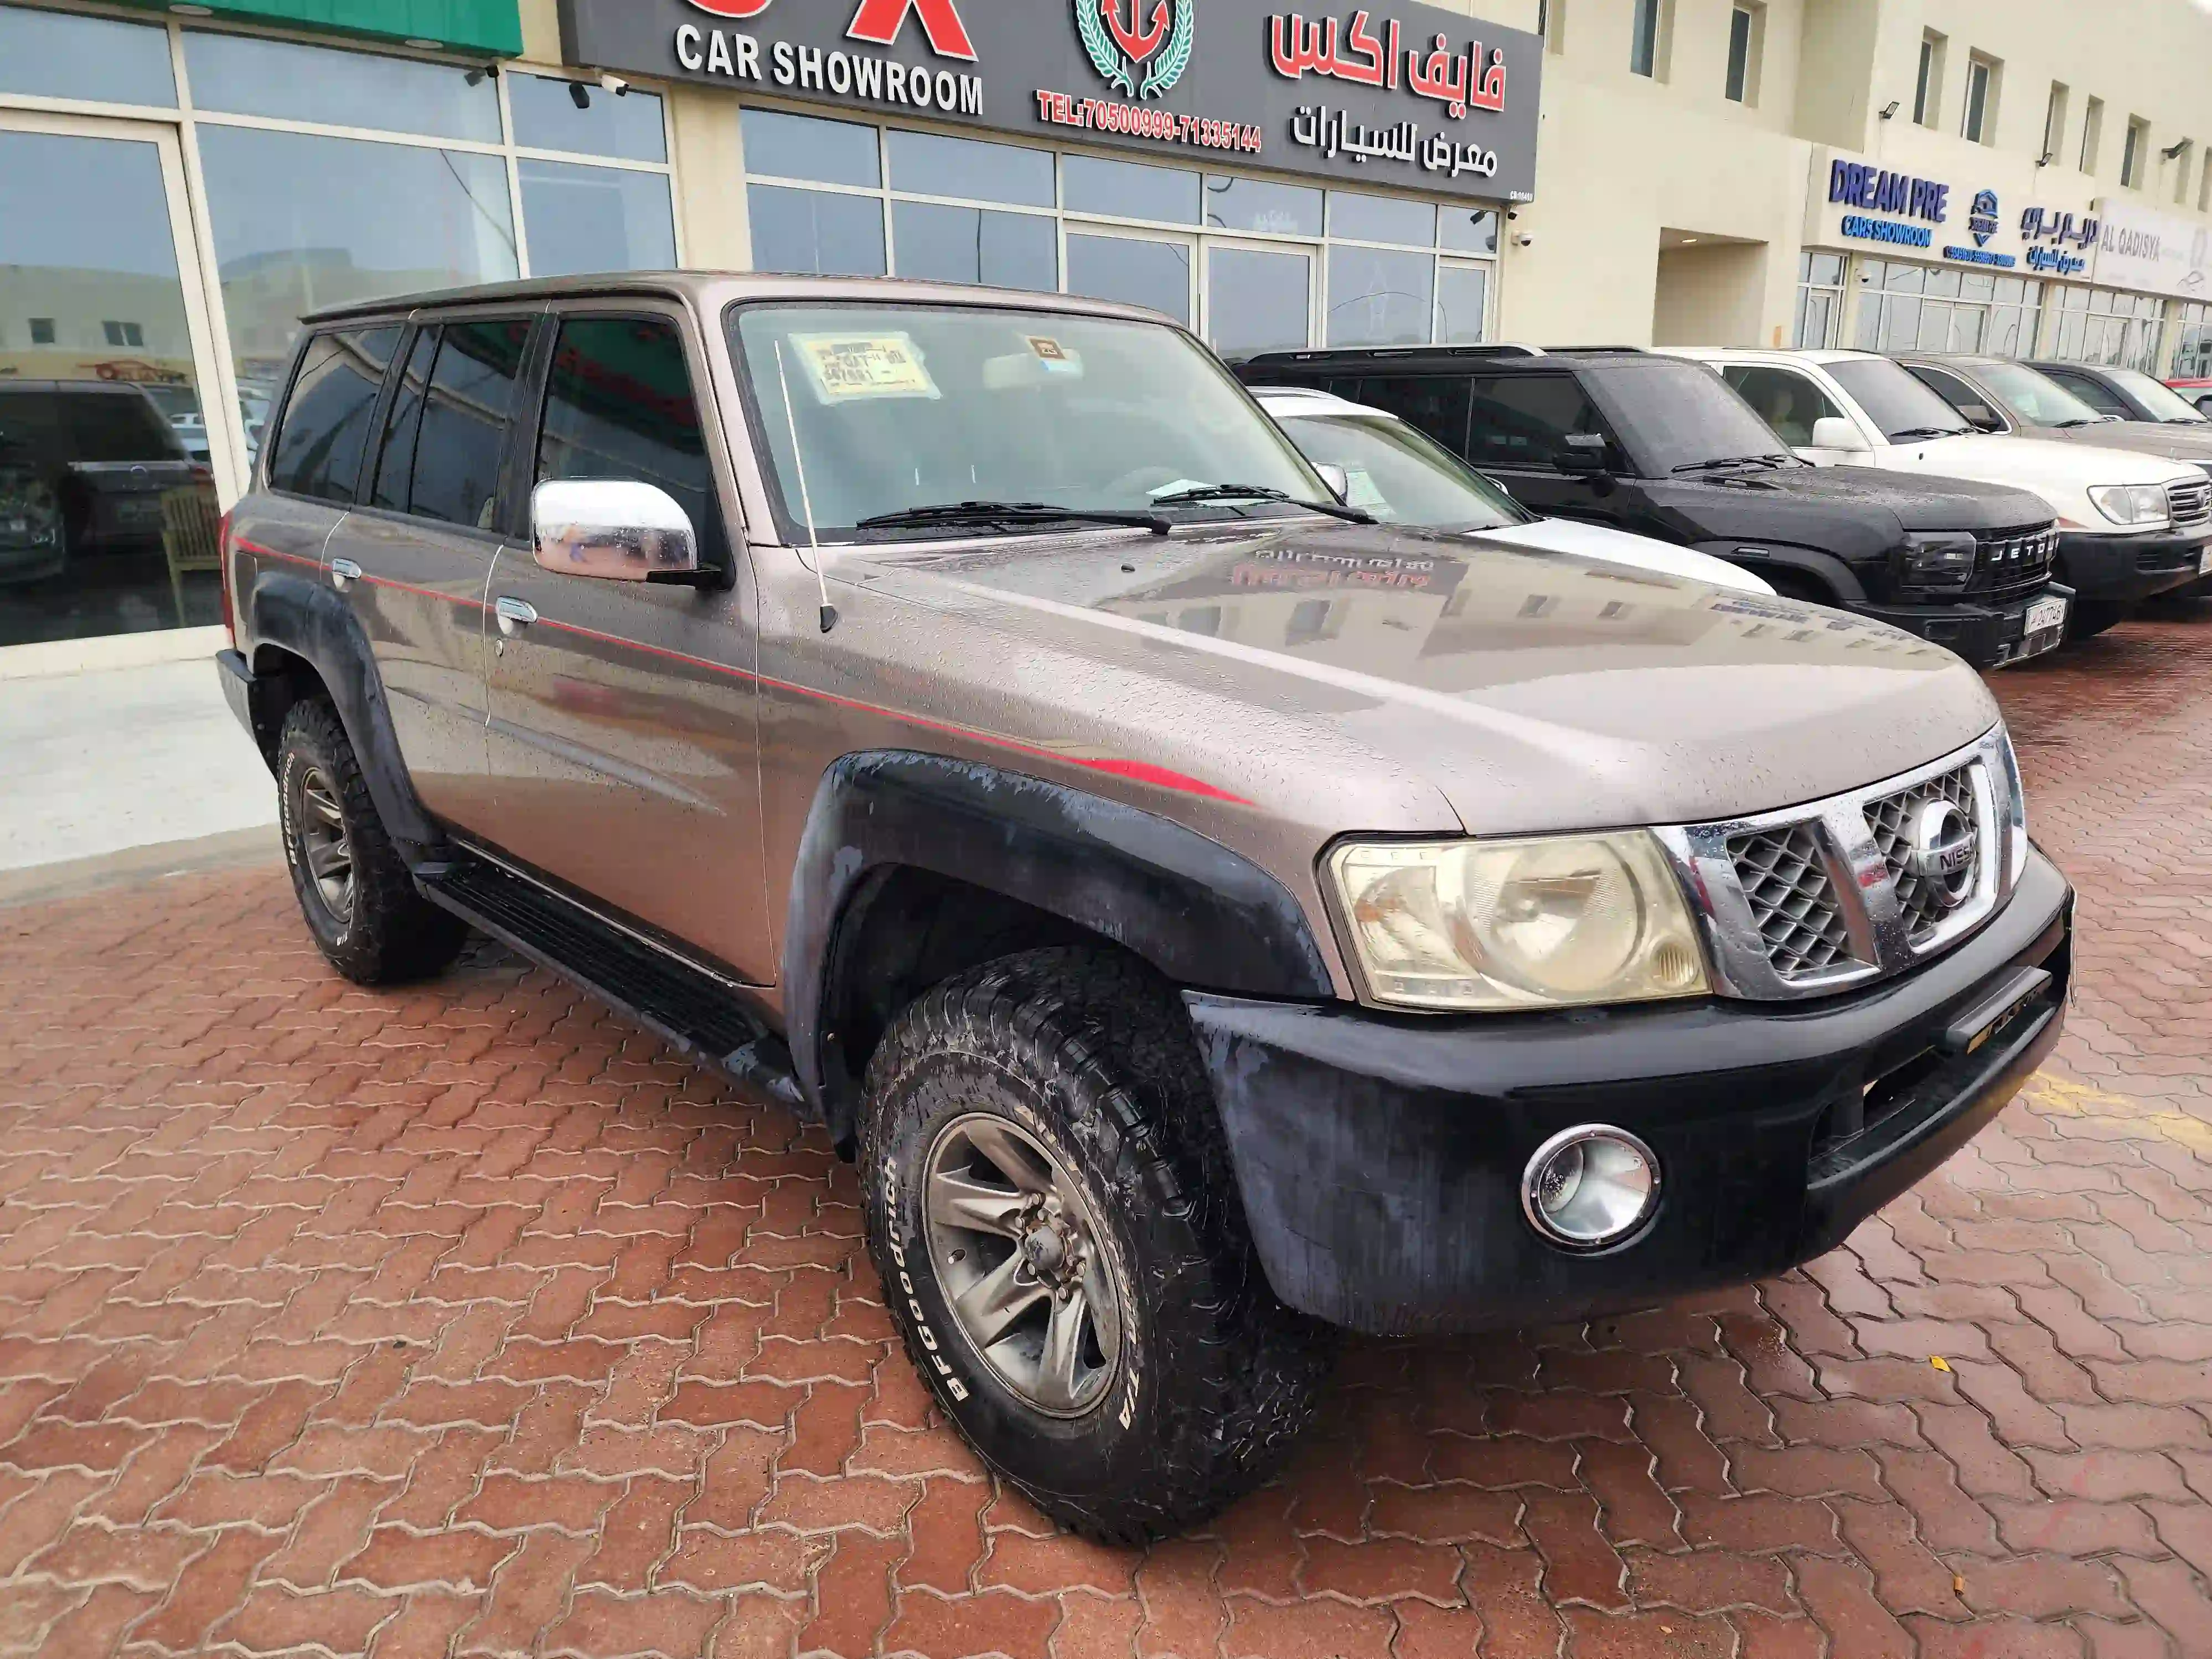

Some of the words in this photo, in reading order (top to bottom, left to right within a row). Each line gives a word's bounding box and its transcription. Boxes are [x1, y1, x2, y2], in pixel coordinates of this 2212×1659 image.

[675, 24, 762, 81] CAR
[773, 40, 983, 115] SHOWROOM
[1272, 10, 1400, 89] اكس
[1408, 33, 1507, 119] فايف
[1036, 89, 1262, 153] TEL:70500999-71335144
[1293, 105, 1418, 162] للسيارات
[1423, 131, 1498, 178] معرض
[1829, 159, 1910, 215] DREAM
[1909, 178, 1950, 223] PRE
[1841, 215, 1874, 239] CARS
[2101, 225, 2114, 252] AL
[1940, 843, 1972, 870] NISS
[885, 1156, 970, 1402] BFGoodrich
[1119, 1366, 1140, 1430] T/A
